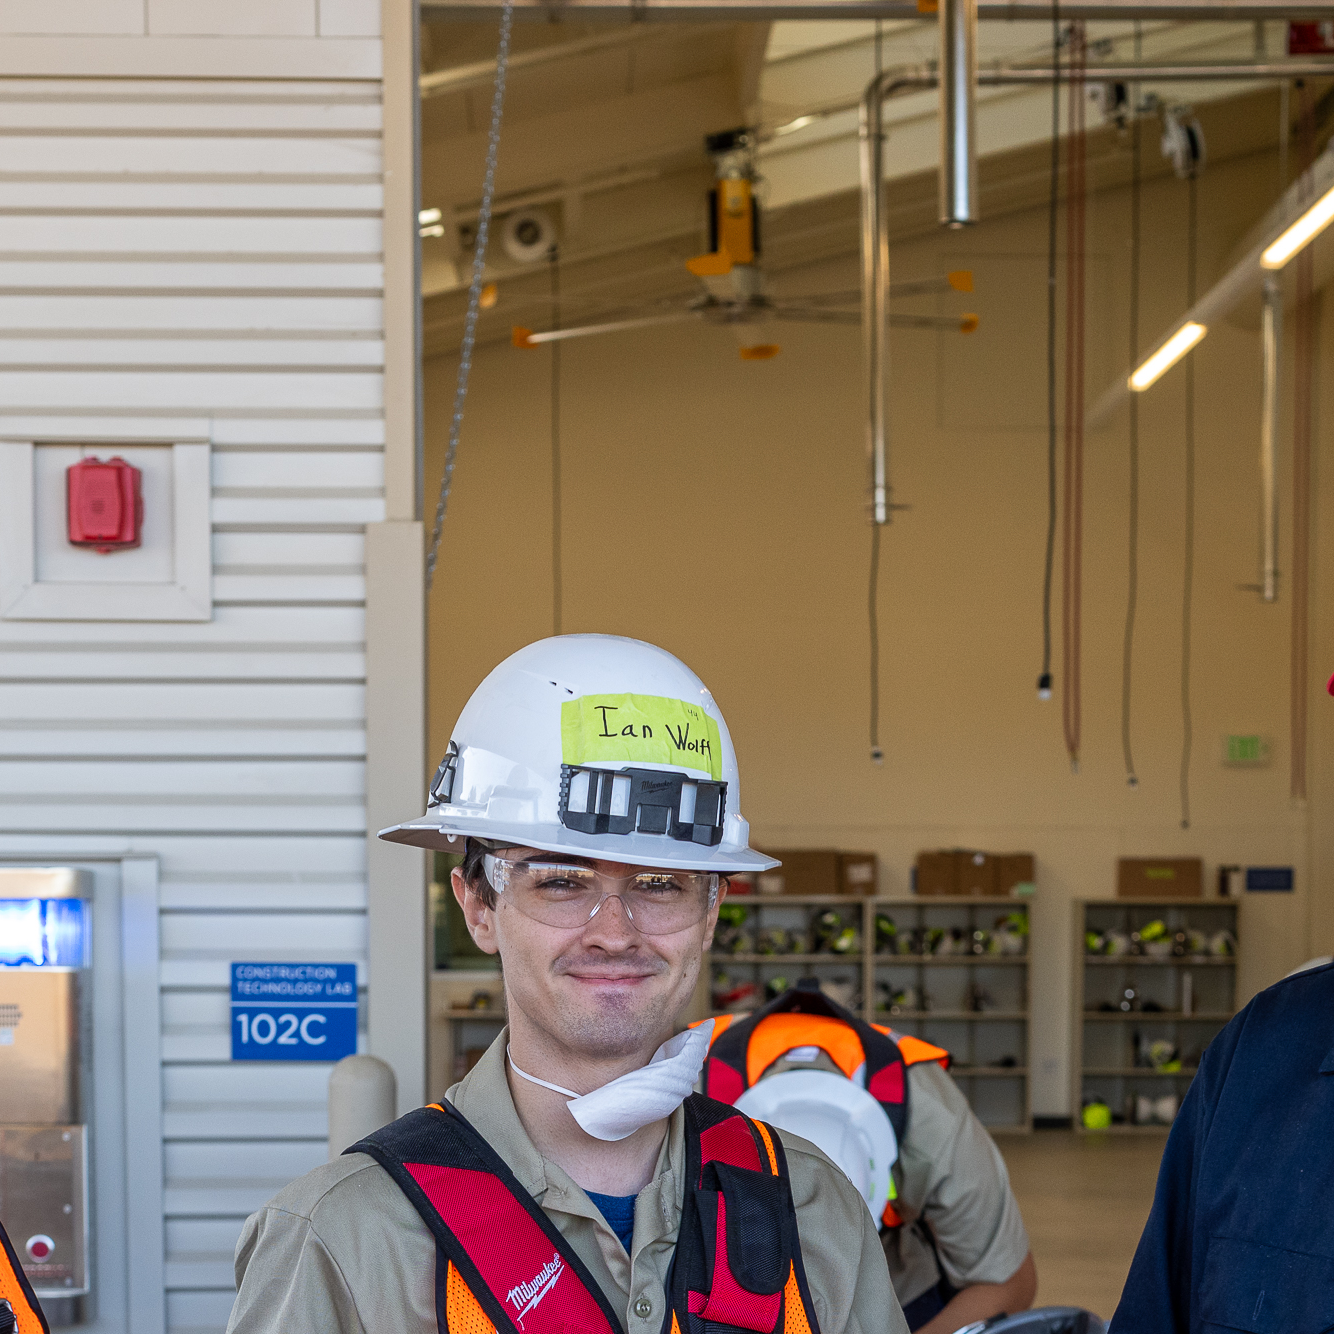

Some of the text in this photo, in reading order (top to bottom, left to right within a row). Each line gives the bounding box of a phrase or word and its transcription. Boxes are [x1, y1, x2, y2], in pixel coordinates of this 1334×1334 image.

[594, 706, 653, 738] Ian
[236, 966, 337, 980] CONSTRUCTION
[237, 981, 353, 995] TECHNOLOGY LAB
[236, 1013, 327, 1045] 102C
[506, 1258, 561, 1310] Milwaukee
